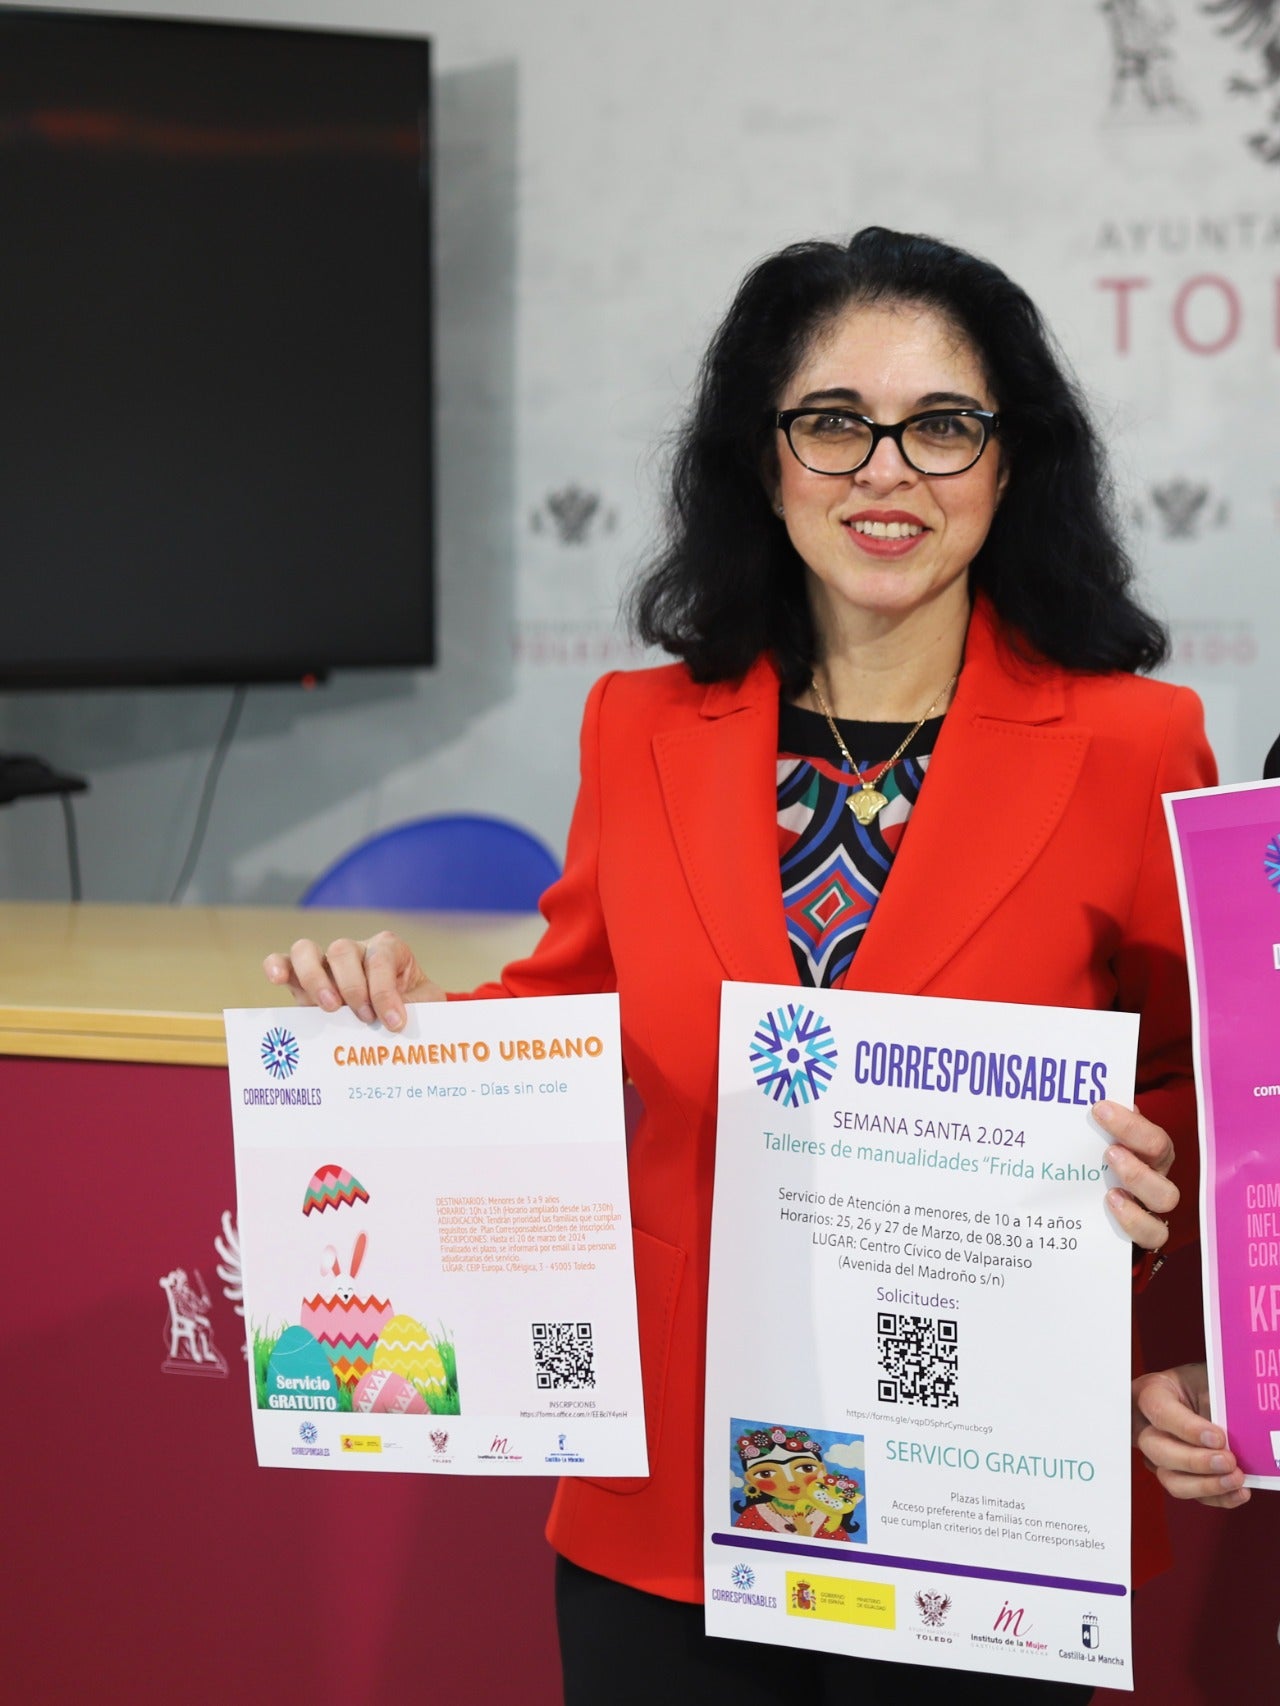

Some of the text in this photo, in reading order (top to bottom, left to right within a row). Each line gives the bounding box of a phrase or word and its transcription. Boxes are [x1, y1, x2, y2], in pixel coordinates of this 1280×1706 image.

[334, 1036, 603, 1066] CAMPAMENTO URBANO
[854, 1040, 1107, 1106] CORRESPONSABLES
[243, 1088, 322, 1106] CORRESPONSABLES
[348, 1080, 568, 1100] 25-26-27 de Marzo Días sin cole
[833, 1110, 1026, 1148] SEMANA SANTA 2.024
[762, 1132, 826, 1156] Talleres
[830, 1139, 852, 1158] de
[857, 1146, 979, 1172] manualidades
[778, 1187, 1082, 1230] Servicio de Atención a menores, de 10 a 14 años
[780, 1207, 1078, 1251] Horarios: 25, 26 y 27 de Marzo, de 08.30 a 14.30
[812, 1232, 1032, 1269] LUGAR: Centro Cívico de Valparaiso
[838, 1255, 1005, 1288] (Avenida del Madroño s/n)
[877, 1286, 959, 1310] Solicitudes:
[276, 1374, 330, 1391] Servicio
[268, 1394, 337, 1411] GRATUITO
[886, 1440, 1095, 1482] SERVICIO GRATUITO
[950, 1492, 1026, 1510] Plazas limitadas
[892, 1500, 1090, 1534] Acceso preferente a familias con menores,
[880, 1515, 1106, 1550] que cumplan criterios del Plan Corresponsables
[712, 1588, 777, 1609] CORRESPONSABLES
[916, 1634, 953, 1644] TOLEDO
[971, 1634, 1003, 1644] Instituto
[1004, 1638, 1014, 1646] de
[1025, 1640, 1048, 1650] Mujer
[1058, 1649, 1096, 1662] Castilla-La
[1098, 1654, 1124, 1666] Mancha
